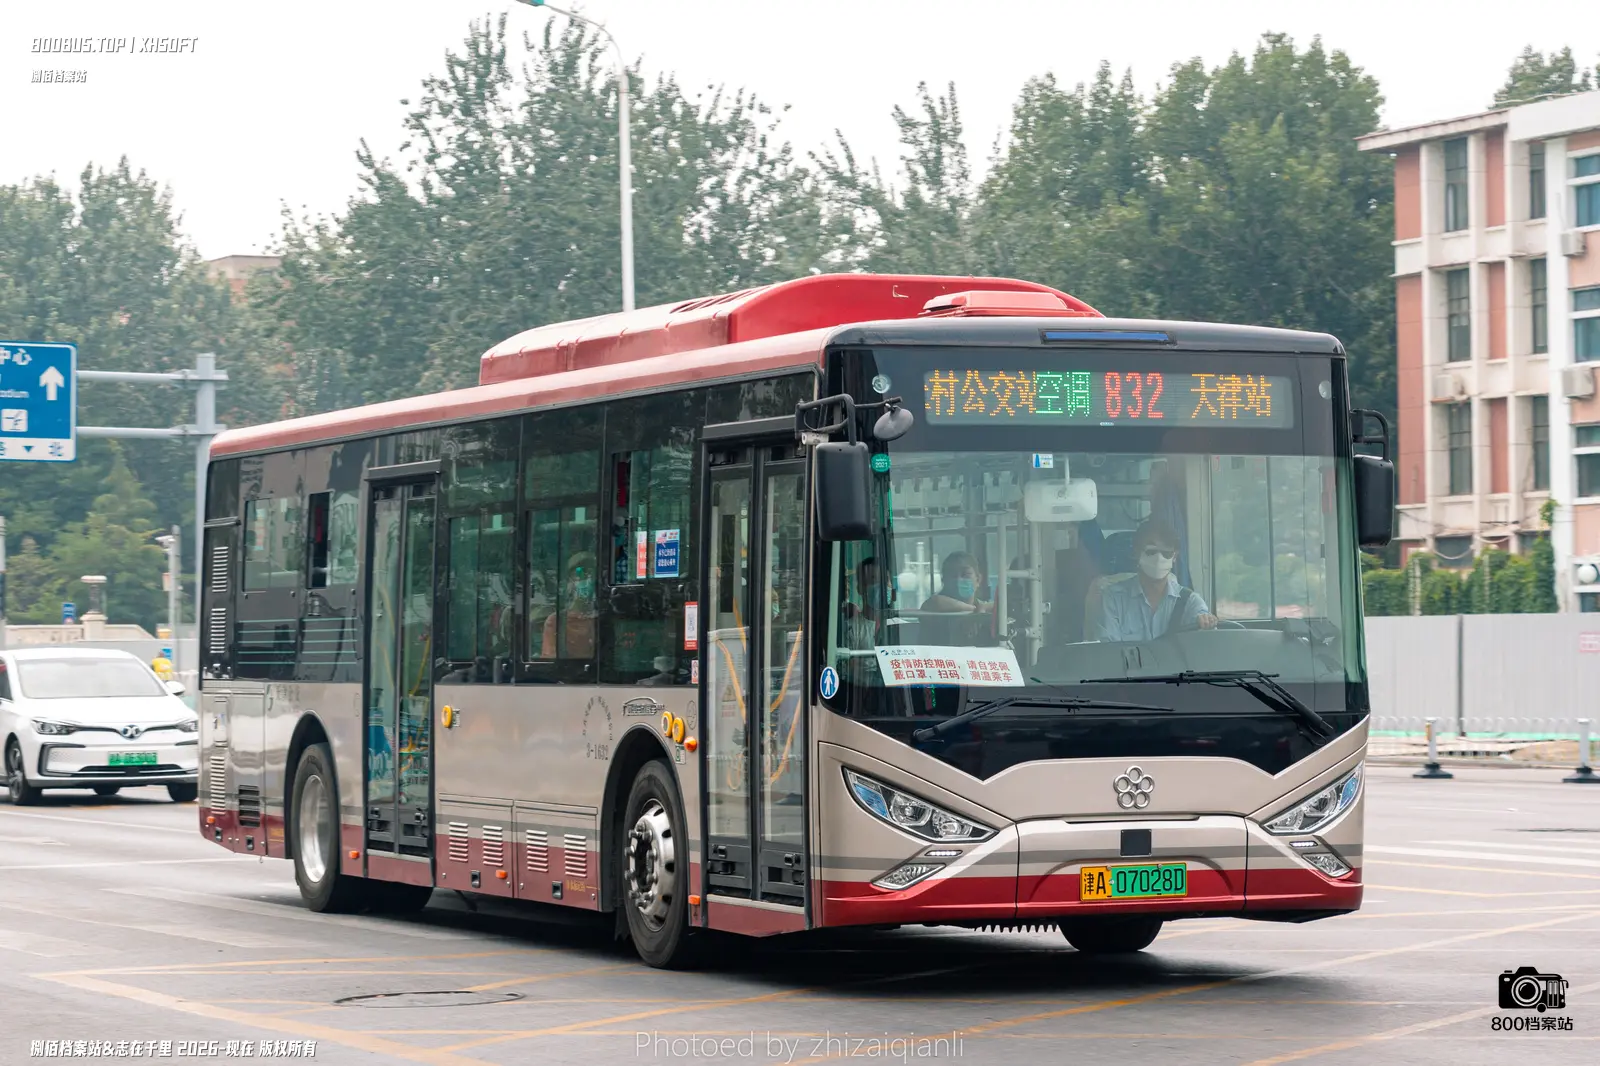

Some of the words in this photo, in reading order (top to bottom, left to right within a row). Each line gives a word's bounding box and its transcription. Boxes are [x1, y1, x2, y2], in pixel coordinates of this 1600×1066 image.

[1035, 370, 1091, 417] 空调
[1104, 372, 1164, 418] 832
[1190, 373, 1273, 419] 天津站
